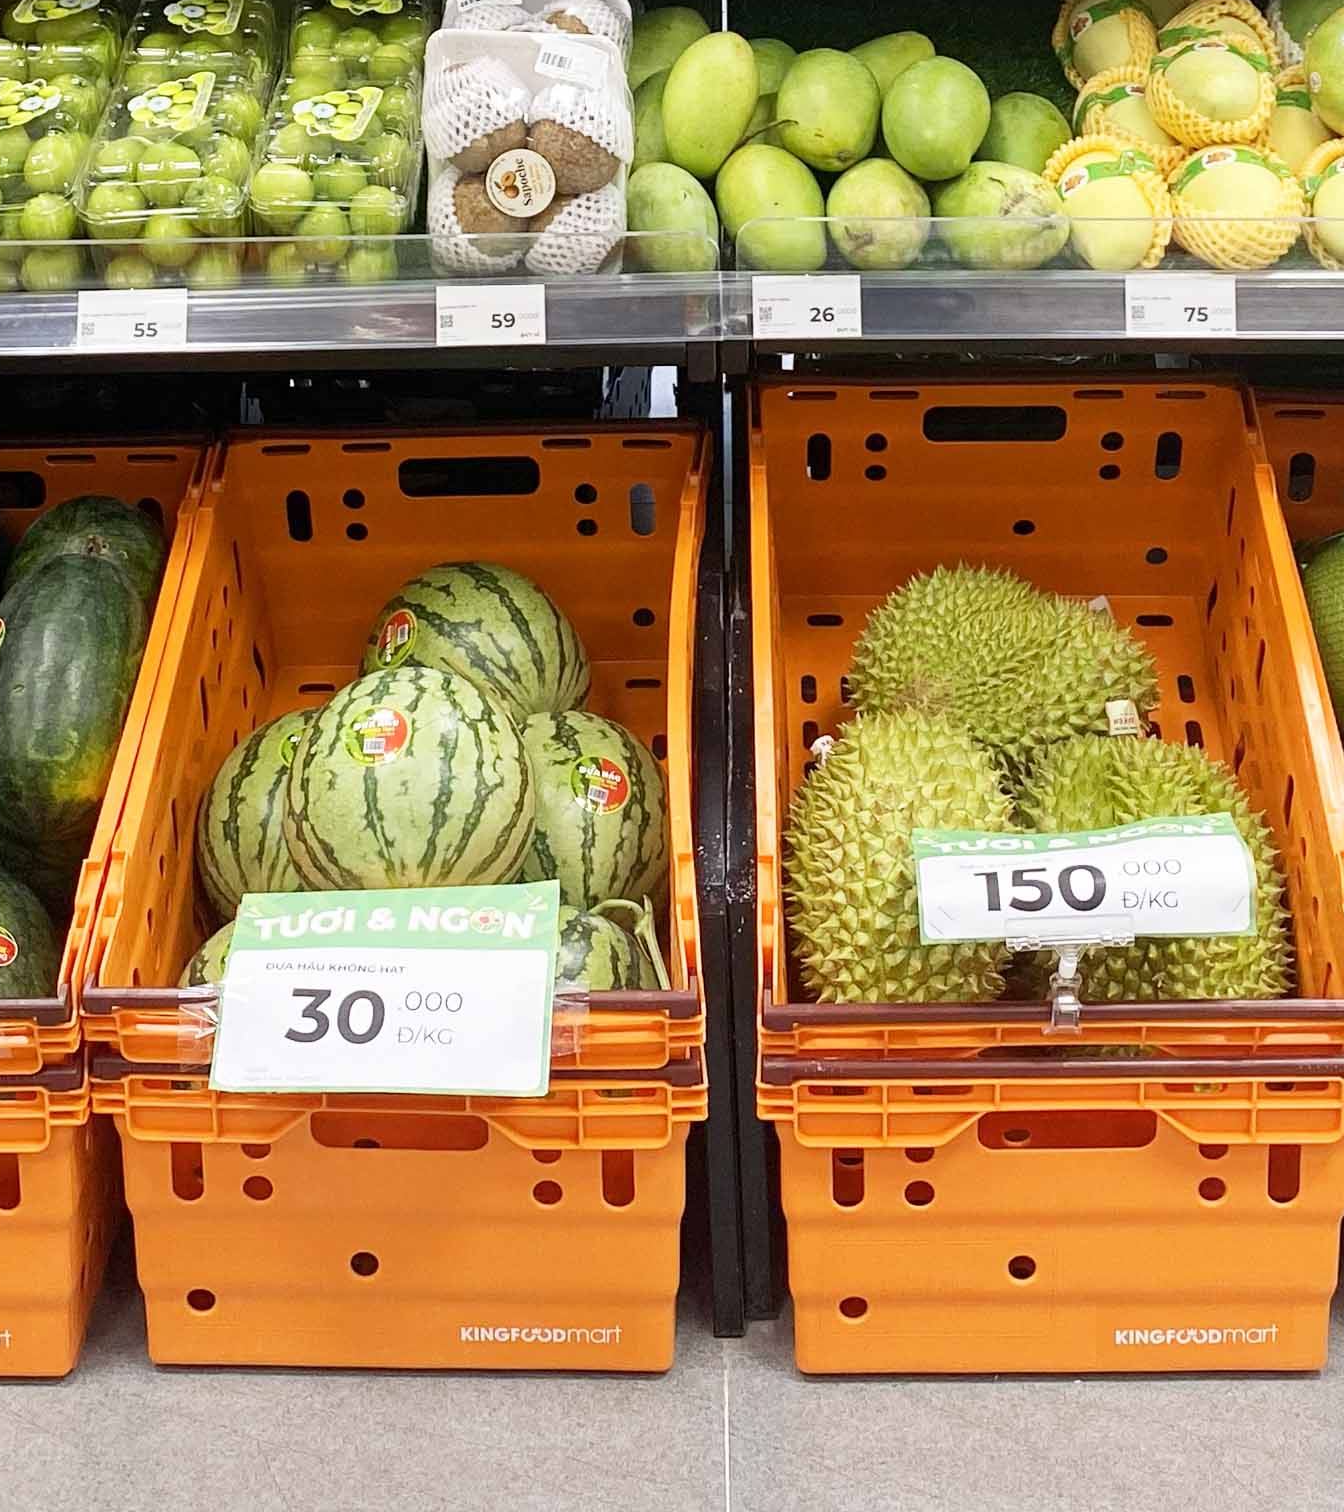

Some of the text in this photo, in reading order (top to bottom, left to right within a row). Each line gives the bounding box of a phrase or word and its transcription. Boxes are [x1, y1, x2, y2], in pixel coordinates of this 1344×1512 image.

[516, 157, 533, 207] Sapoche
[491, 313, 516, 328] 59
[809, 307, 835, 322] 26
[1184, 307, 1209, 322] 75
[133, 322, 158, 337] 55
[974, 865, 1107, 912] 150
[1121, 891, 1179, 910] Đ/KG
[256, 905, 536, 940] TƯƠI & NGON
[284, 988, 386, 1044] 30
[460, 1325, 622, 1345] KINGFOODmart
[1114, 1323, 1278, 1346] KINGFOODmart
